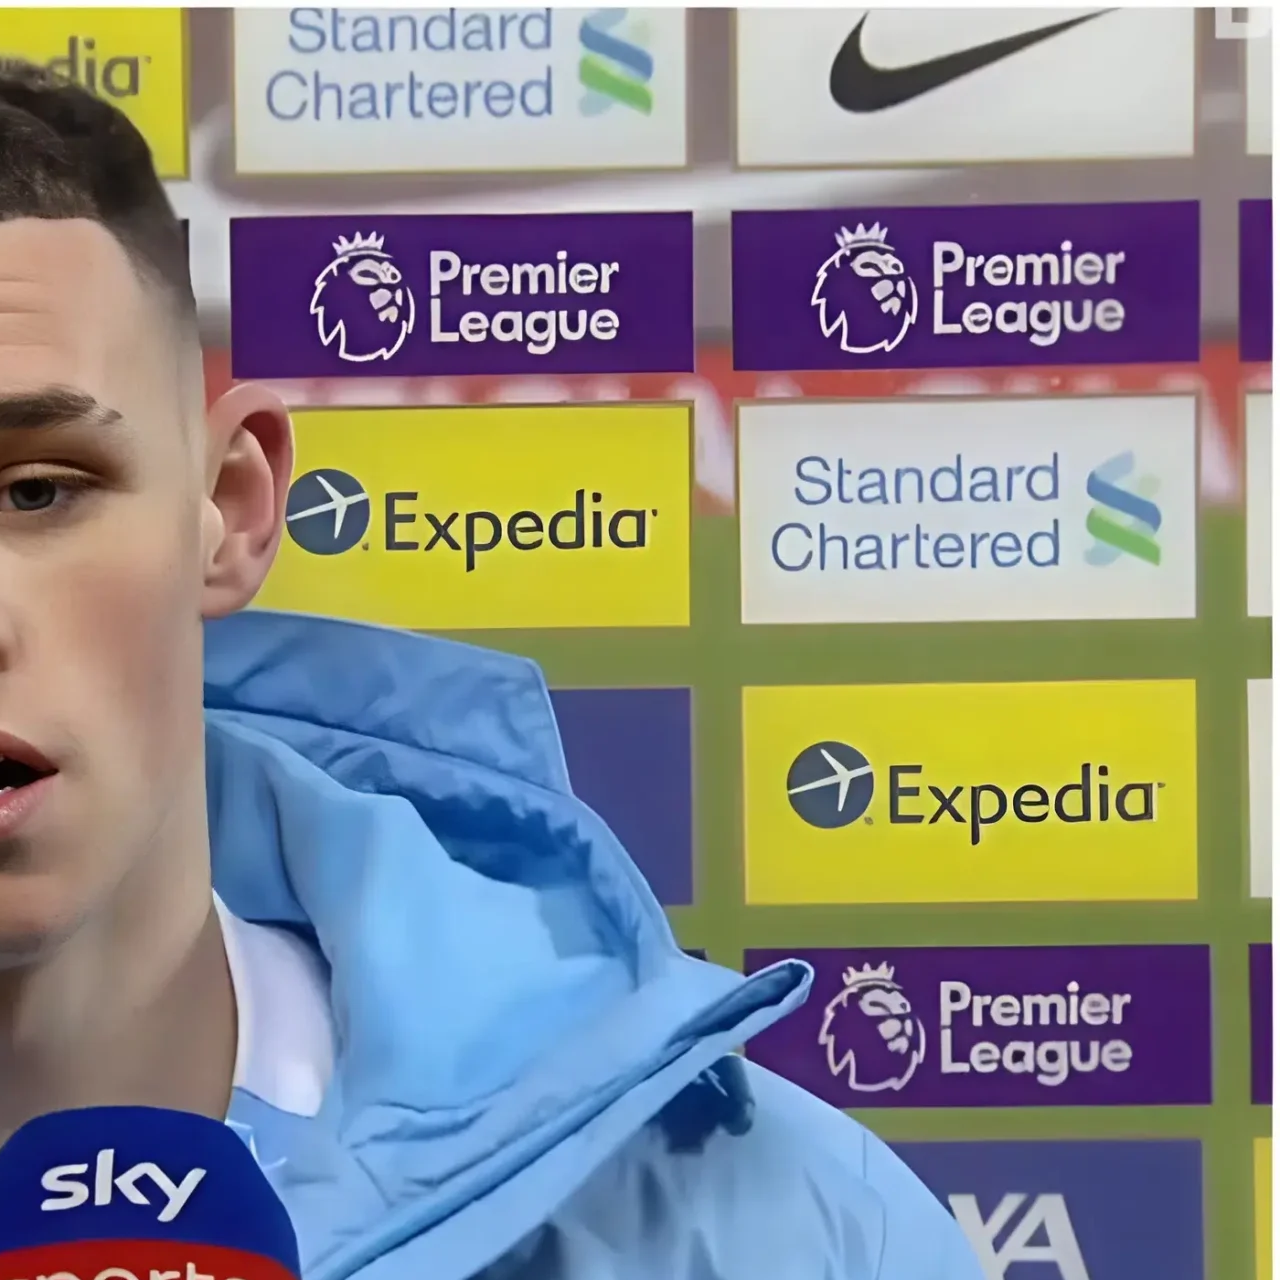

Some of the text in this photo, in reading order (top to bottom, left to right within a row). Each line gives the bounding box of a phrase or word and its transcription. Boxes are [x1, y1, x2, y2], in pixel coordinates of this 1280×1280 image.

[288, 8, 552, 54] Standard
[265, 65, 553, 121] Chartered
[429, 250, 620, 296] Premier
[932, 240, 1125, 289] Premier
[430, 297, 620, 355] League
[932, 289, 1125, 347] League
[793, 451, 1060, 506] Standard
[385, 488, 647, 573] Expedia
[770, 518, 1061, 573] Chartered
[888, 762, 1158, 846] Expedia
[939, 981, 1132, 1029] Premier
[939, 1028, 1133, 1087] League
[39, 1148, 207, 1223] sky
